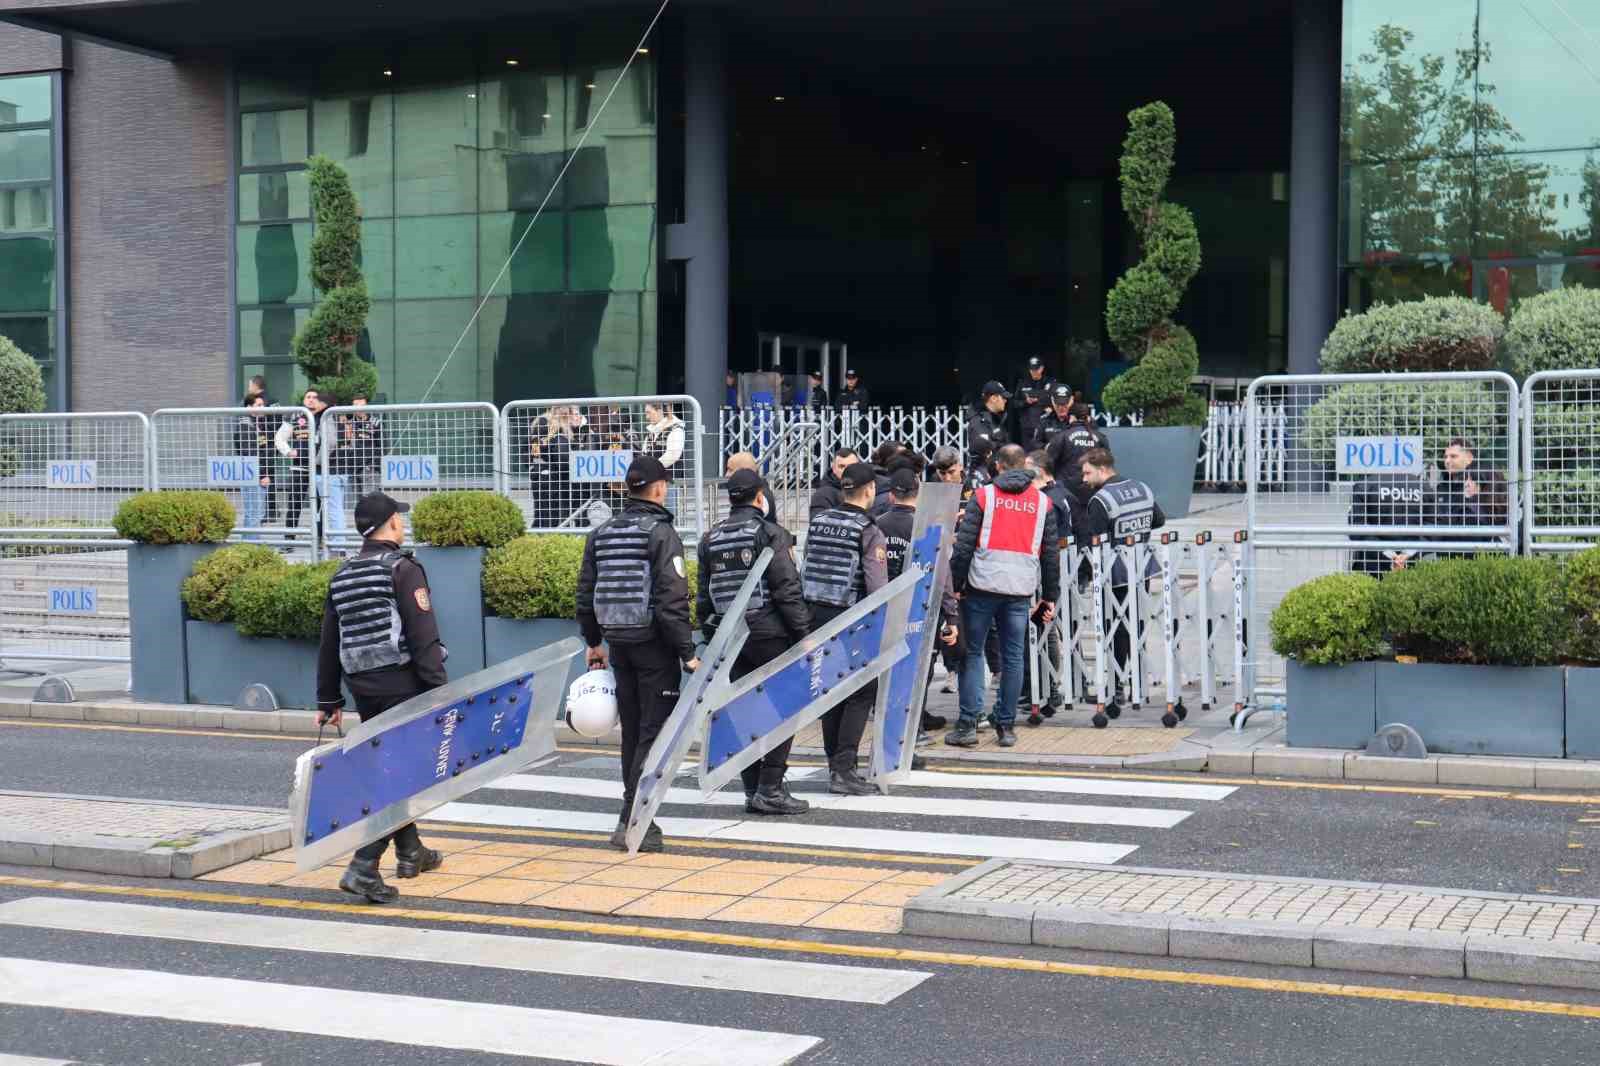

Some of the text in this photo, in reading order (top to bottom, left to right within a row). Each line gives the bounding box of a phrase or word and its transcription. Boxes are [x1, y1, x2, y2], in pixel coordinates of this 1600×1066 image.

[576, 452, 628, 477] POLİS
[1345, 437, 1414, 467] POLİS
[52, 463, 92, 484] POLİS
[211, 456, 255, 482] POLİS
[387, 456, 433, 481] POLİS
[52, 587, 94, 611] POLİS
